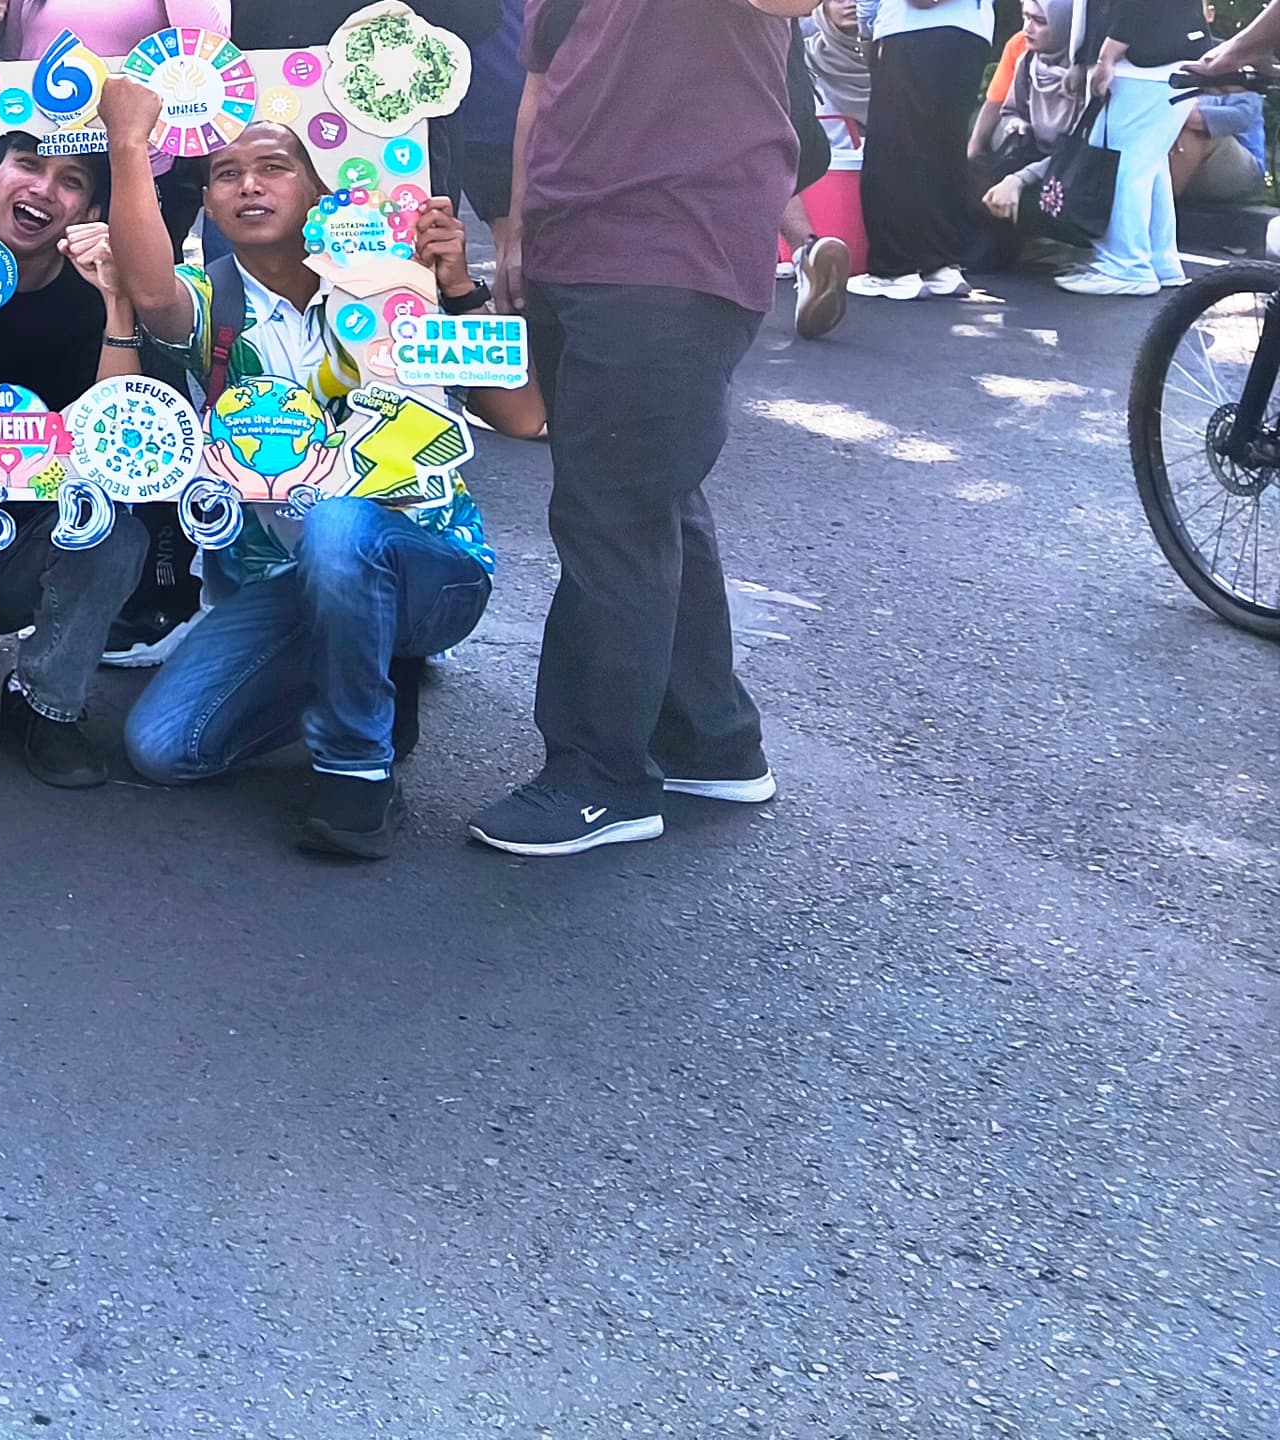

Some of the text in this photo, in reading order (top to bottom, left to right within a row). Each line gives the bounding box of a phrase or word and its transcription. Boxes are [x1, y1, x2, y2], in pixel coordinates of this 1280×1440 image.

[167, 102, 208, 116] UNNES
[42, 131, 107, 144] BERGERAK
[330, 222, 385, 230] SUSTAINABLE
[426, 320, 521, 341] BE THE
[398, 345, 522, 366] CHANGE
[403, 370, 522, 384] Take the Challenge
[225, 416, 251, 426] Save
[254, 414, 271, 424] the
[75, 381, 195, 497] REFUSE REDUCE REPAIR REUSE RECYCLE ROT
